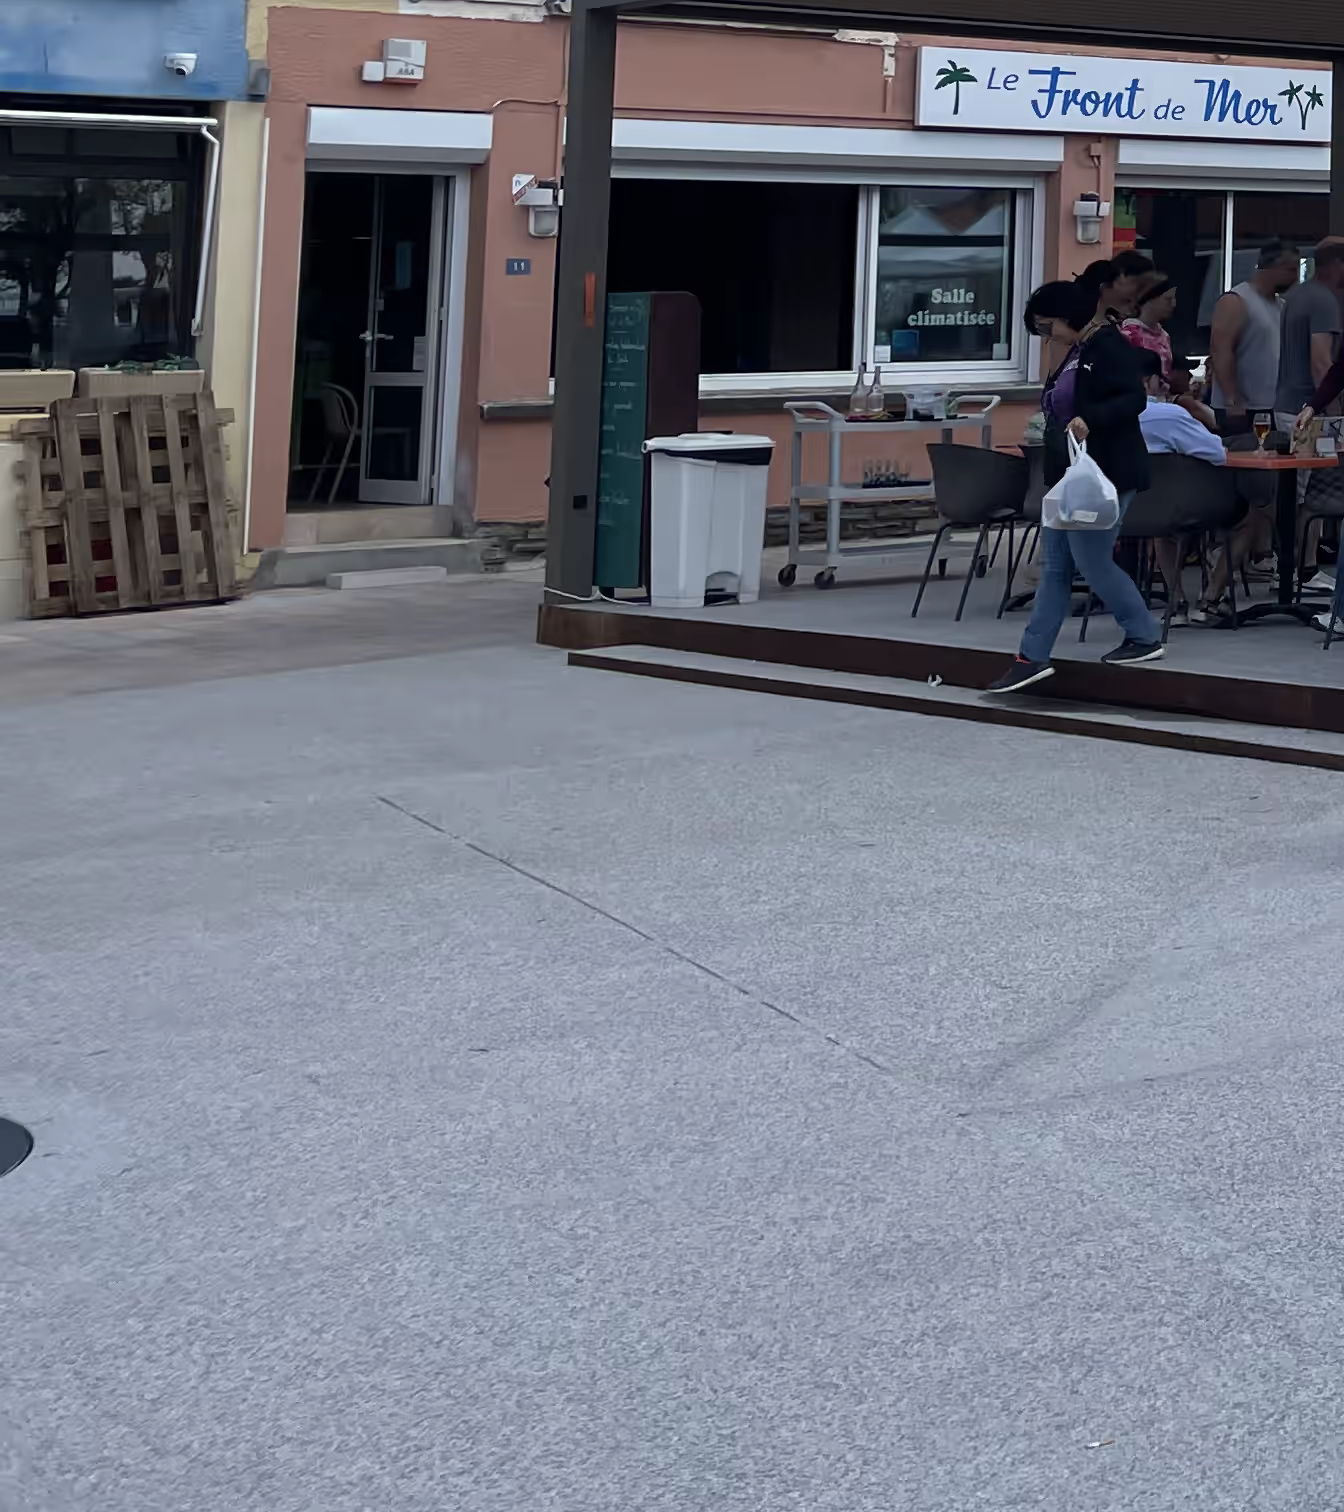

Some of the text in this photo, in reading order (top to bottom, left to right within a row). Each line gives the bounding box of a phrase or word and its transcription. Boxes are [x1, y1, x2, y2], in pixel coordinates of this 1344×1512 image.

[987, 65, 1283, 126] Le Front de Mer
[513, 262, 525, 271] 11
[931, 288, 975, 304] Salle
[907, 309, 996, 326] climatisée
